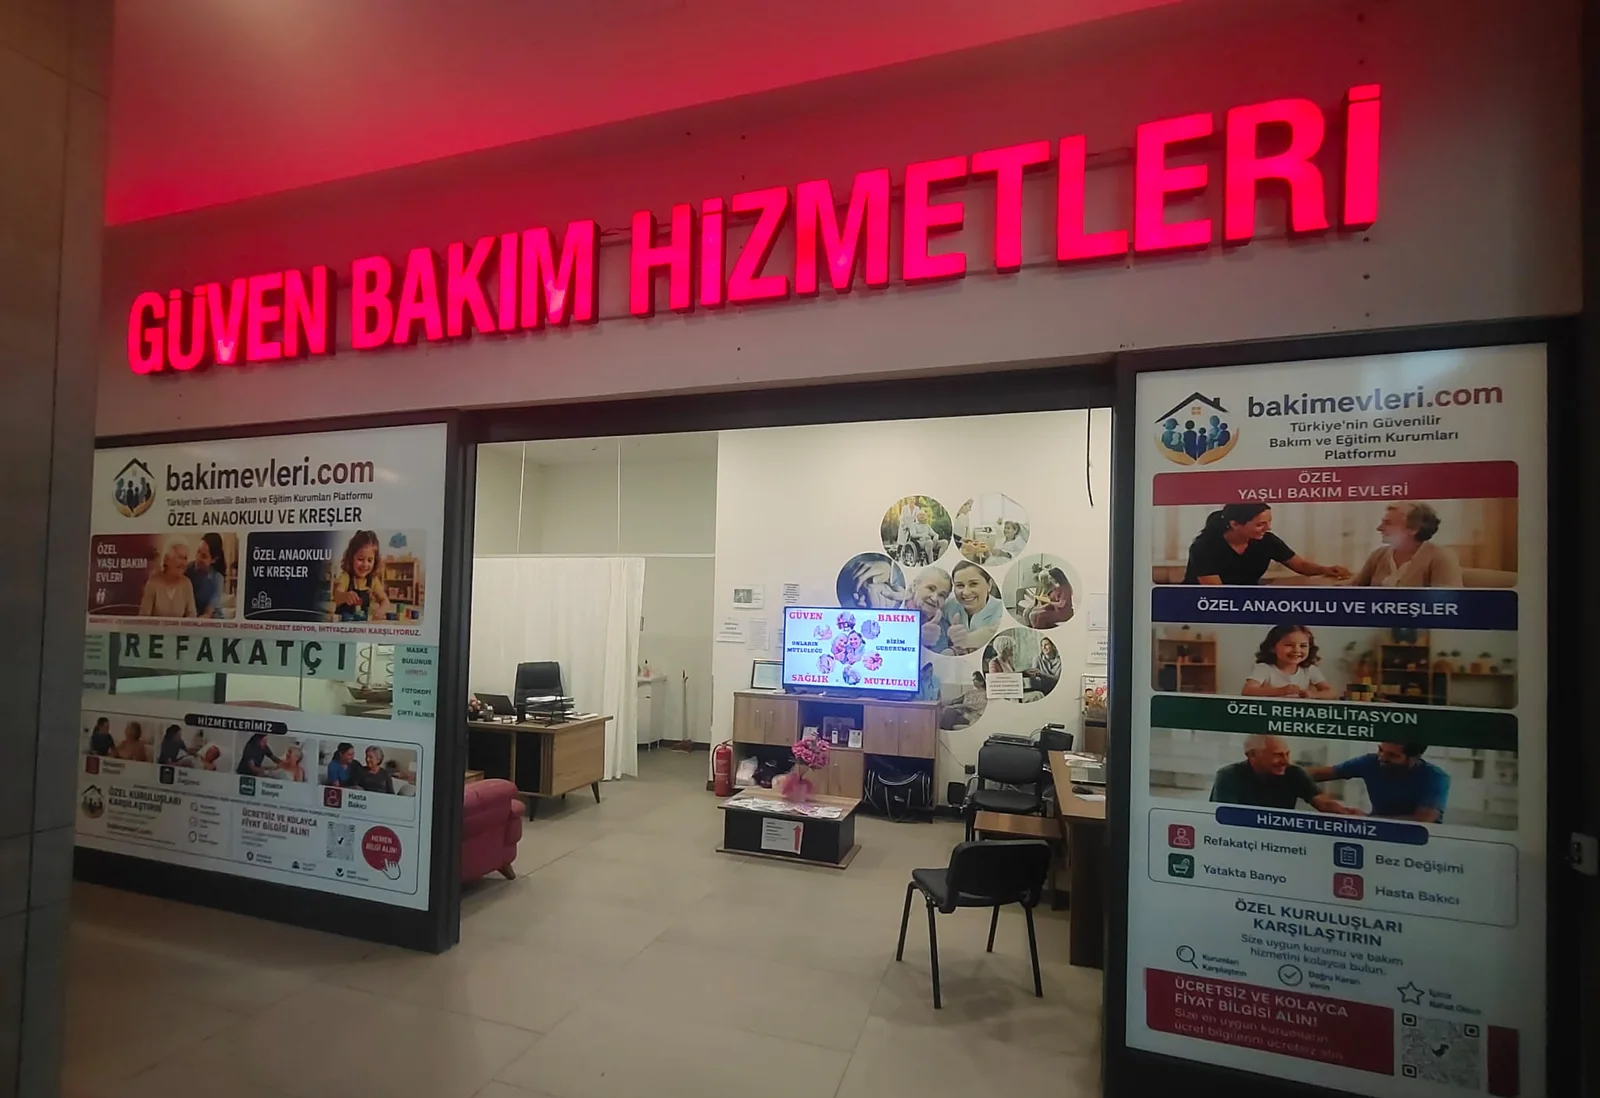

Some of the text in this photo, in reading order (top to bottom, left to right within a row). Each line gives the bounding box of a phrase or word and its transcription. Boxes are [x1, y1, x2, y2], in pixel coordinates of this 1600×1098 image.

[128, 83, 1381, 375] GÜVEN BAKIM HİZMETLERİ
[1248, 386, 1503, 418] bakimevleri.com
[1290, 415, 1442, 434] Türkiye'nin Güvenilir
[1269, 430, 1459, 448] Bakım ve Eğitim Kurumları
[1324, 448, 1397, 460] Platformu
[166, 456, 374, 492] bakimevleri.com
[1299, 471, 1341, 484] ÖZEL
[235, 495, 257, 504] Bakım
[269, 493, 292, 505] Eğitim
[293, 491, 332, 502] Kurumları
[333, 490, 373, 501] Platformu
[1238, 483, 1408, 503] YAŞLI BAKIM EVLERİ
[168, 507, 362, 527] ÖZEL ANAOKULU VE KREŞLER
[97, 541, 118, 555] ÖZEL
[252, 546, 332, 561] ÖZEL ANAOKULU
[96, 558, 148, 569] YAŞLI BAKIM
[252, 565, 308, 581] VE KREŞLER
[789, 610, 916, 622] GÜVEN BAKIM
[1197, 597, 1459, 617] ÖZEL ANAOKULU VE KREŞLER
[406, 646, 429, 654] MASKE
[401, 658, 433, 666] BULUNUR
[791, 672, 829, 683] SAĞLIK
[864, 677, 917, 687] MUTLULUK
[1227, 701, 1418, 725] ÖZEL REHABİLİTASYON
[198, 716, 273, 732] HİZMETLERİMİZ
[1268, 721, 1375, 738] MERKEZLERİ
[348, 792, 367, 801] Hasta
[241, 807, 276, 820] ÜCRETSİZ
[276, 813, 285, 823] VE
[287, 814, 318, 828] KOLAYCA
[1256, 812, 1377, 837] HİZMETLERİMİZ
[371, 835, 393, 844] HEMEN
[1203, 835, 1307, 856] Refakatçi Hizmeti
[1203, 863, 1287, 884] Yatakta Banyo
[1376, 855, 1465, 875] Bez Değişimi
[1375, 886, 1461, 906] Hasta Bakıcı
[1234, 898, 1403, 934] ÖZEL KURULUŞLARI
[1252, 918, 1383, 947] KARŞILAŞTIRIN
[1241, 933, 1404, 967] Size uygun kurumu ve bakım
[1250, 947, 1388, 976] hizmetini kolayca bulun.
[1175, 976, 1349, 1018] ÜCRETSİZ VE KOLAYCA
[1174, 1008, 1199, 1020] Size
[1202, 1013, 1217, 1023] en
[1220, 1016, 1258, 1031] uygun
[1175, 992, 1318, 1027] FİYAT BİLGİSİ ALIN!
[1174, 1022, 1204, 1034] ücret
[1208, 1026, 1264, 1045] bilgilerini
